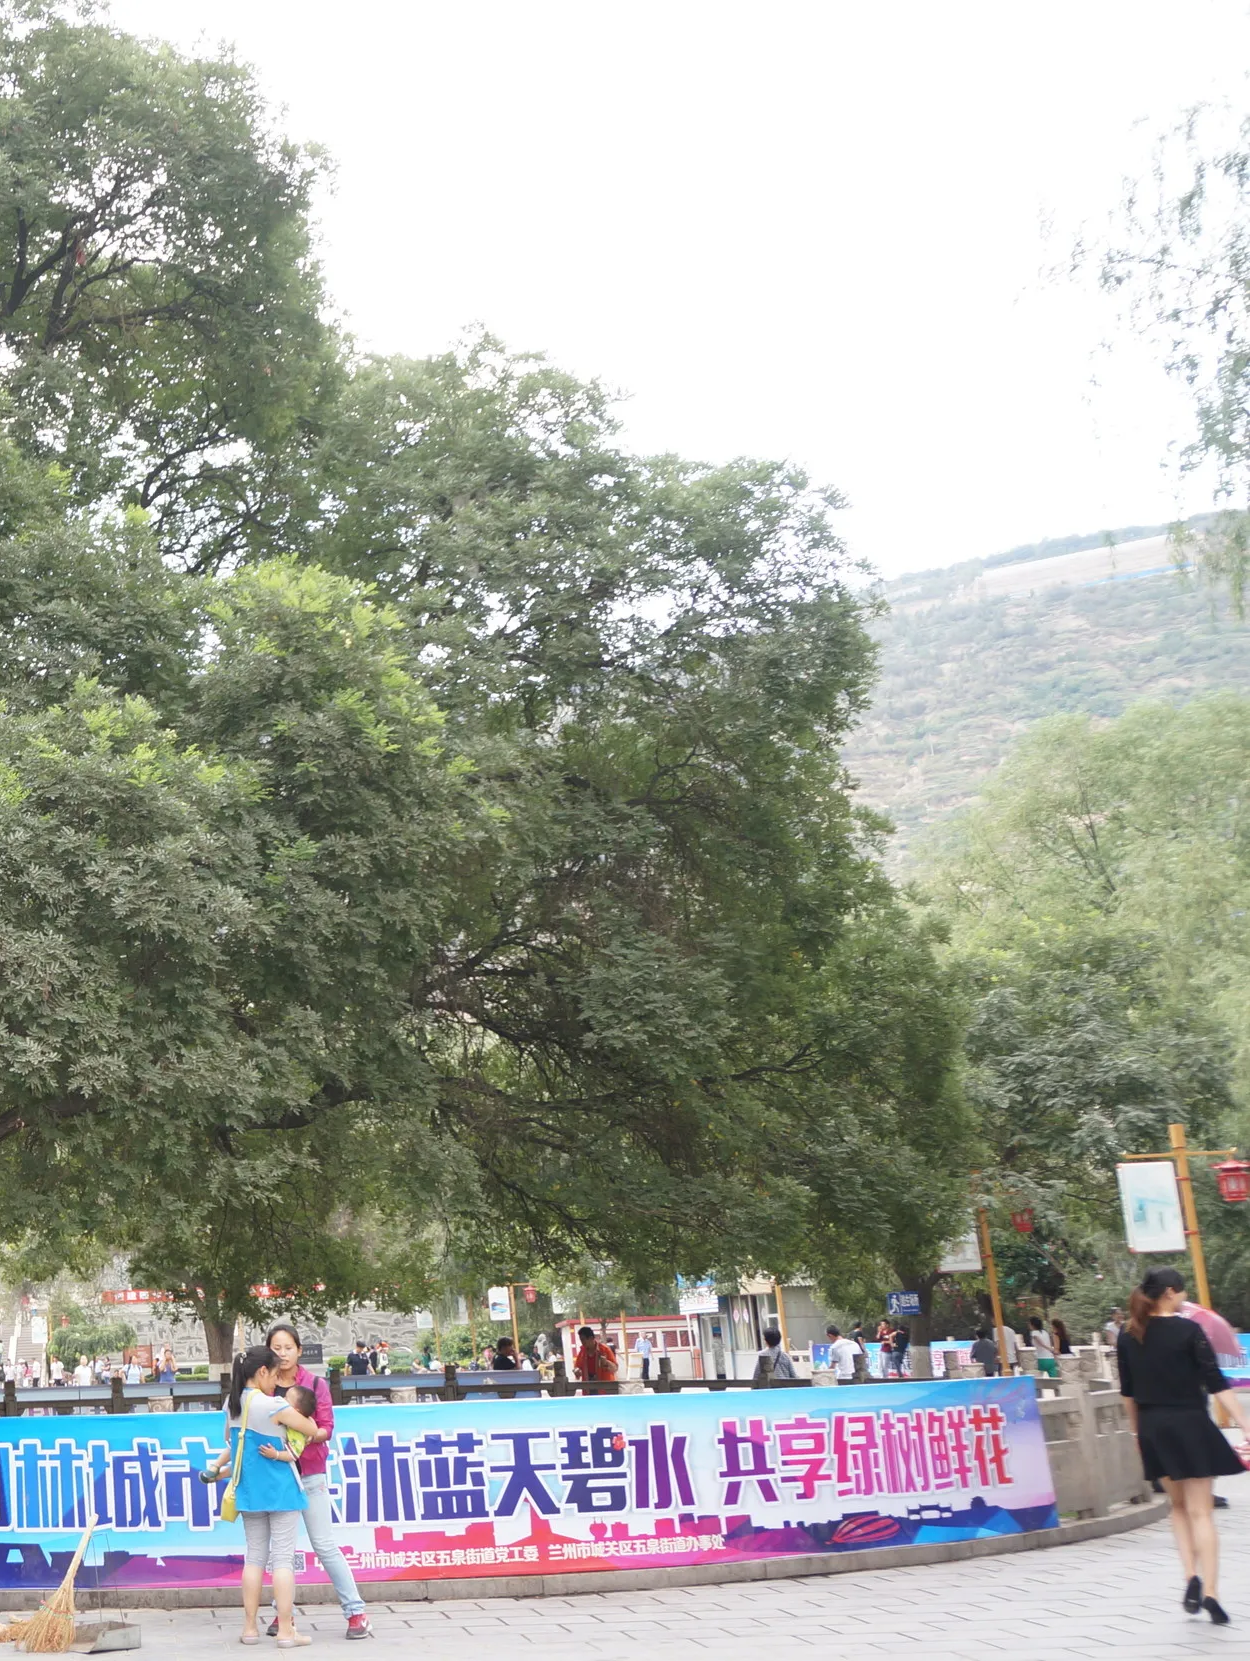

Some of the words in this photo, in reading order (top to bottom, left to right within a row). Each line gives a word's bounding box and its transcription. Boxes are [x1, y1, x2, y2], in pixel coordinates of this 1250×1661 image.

[328, 1422, 698, 1527] 沐蓝天碧水
[715, 1403, 1016, 1507] 共享绿树鲜花
[313, 1543, 541, 1572] 兰州市城关区五泉街道党工委
[547, 1534, 726, 1562] 兰州市城关区五泉街道办事处
